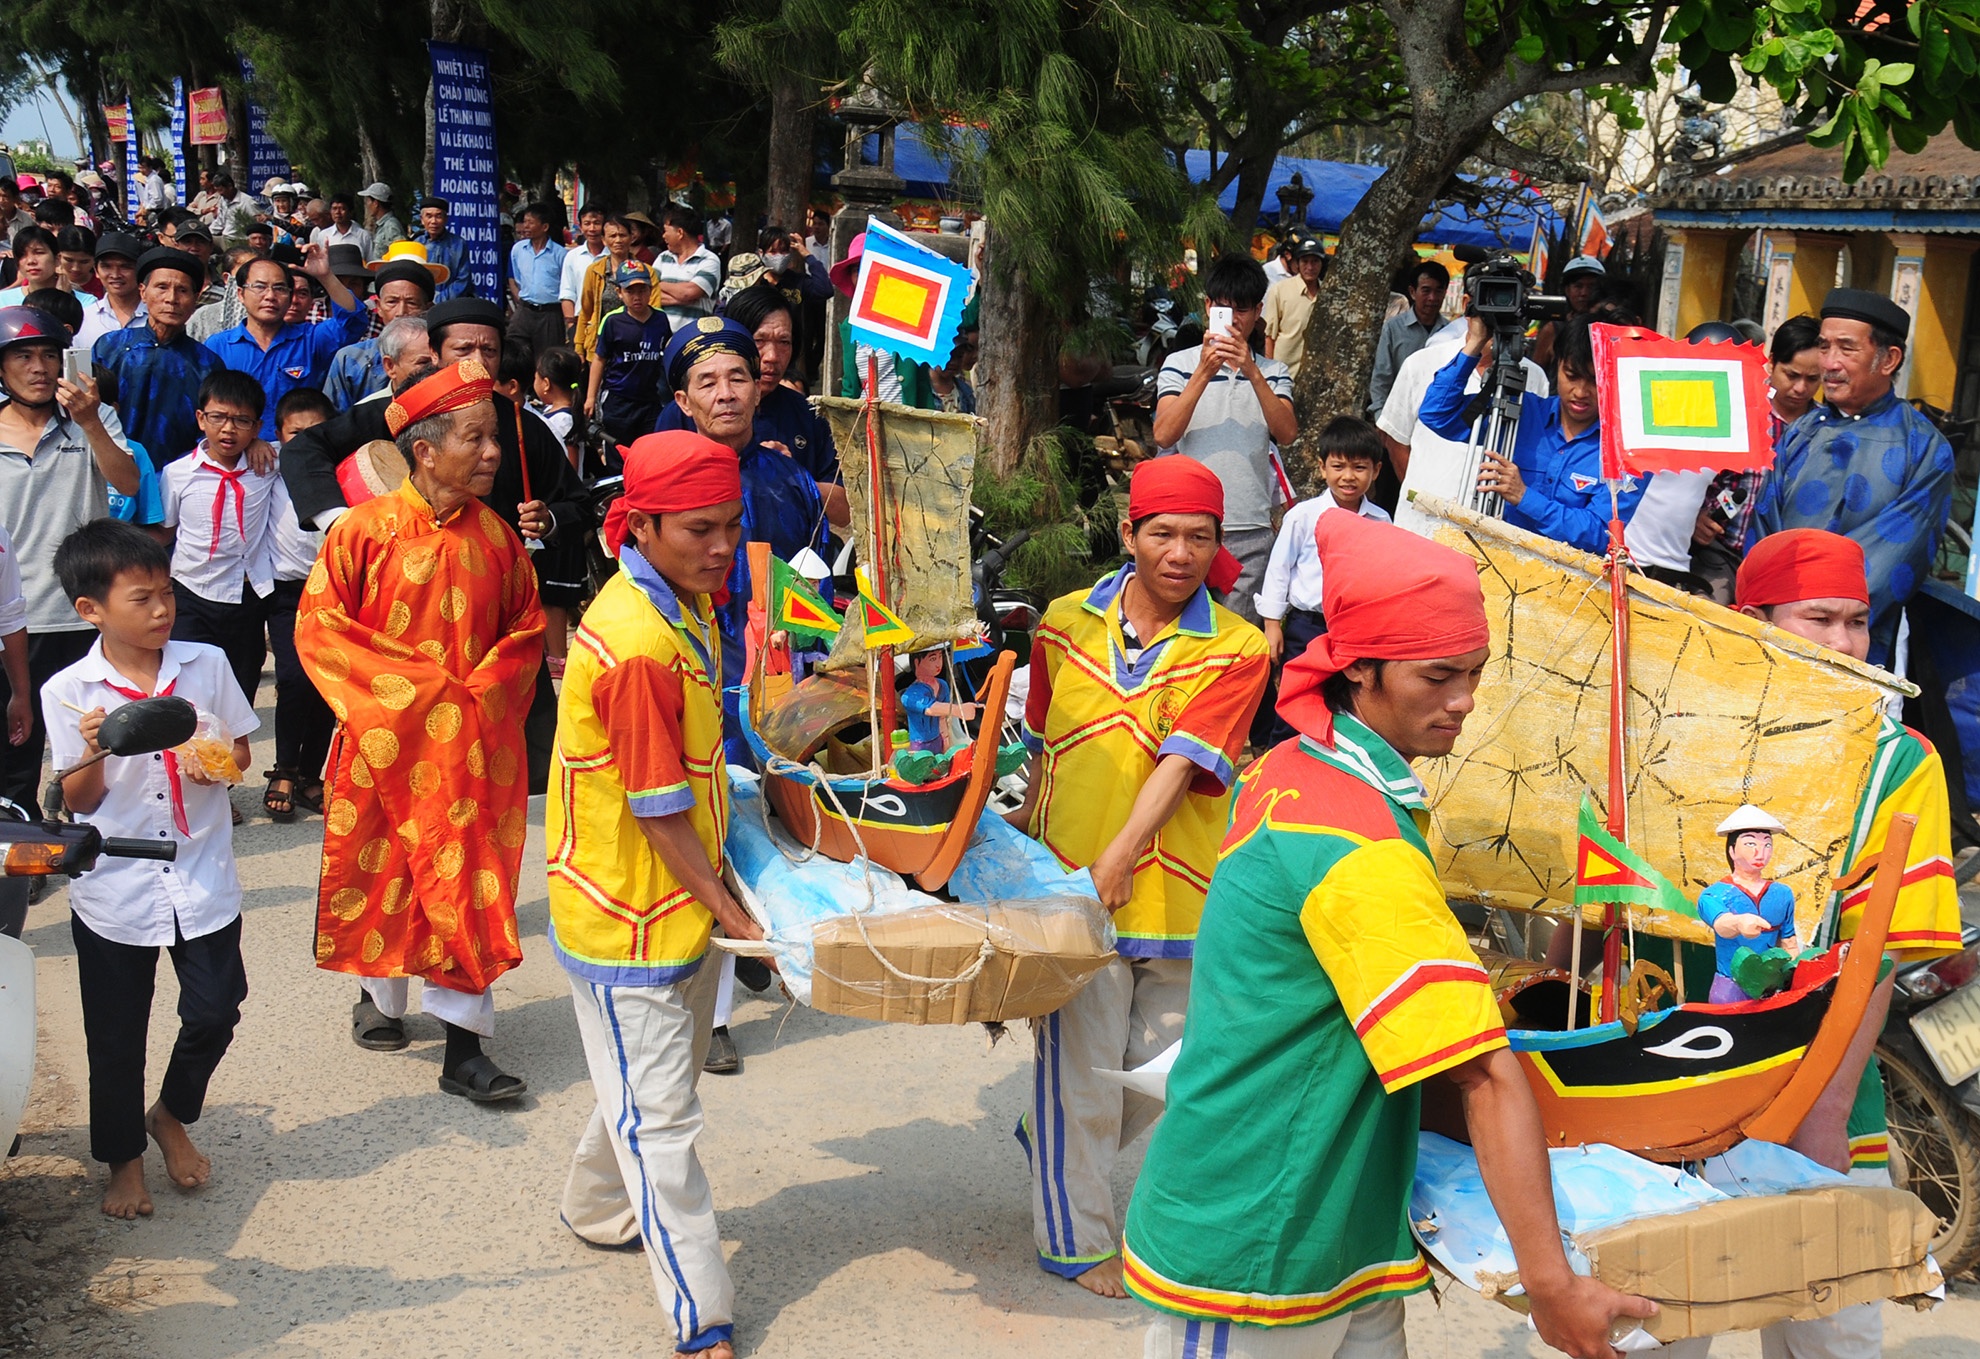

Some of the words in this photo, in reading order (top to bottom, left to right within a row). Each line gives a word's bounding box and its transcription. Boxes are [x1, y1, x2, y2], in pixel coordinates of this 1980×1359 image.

[436, 58, 463, 80] NHIỆT
[465, 62, 485, 83] LIỆT
[439, 82, 462, 101] CHÀO
[464, 85, 489, 104] MỪNG
[449, 108, 474, 125] THANH
[440, 128, 452, 147] VÀ
[462, 134, 484, 149] KHAO
[265, 150, 276, 160] AN
[443, 153, 465, 171] THẾ
[469, 156, 494, 173] LÍNH
[440, 175, 479, 194] HOÀNG
[454, 199, 477, 217] ĐÌNH
[460, 226, 476, 242] AN
[478, 223, 497, 242] HẢI
[469, 246, 481, 264] LÝ
[482, 248, 498, 265] SƠN
